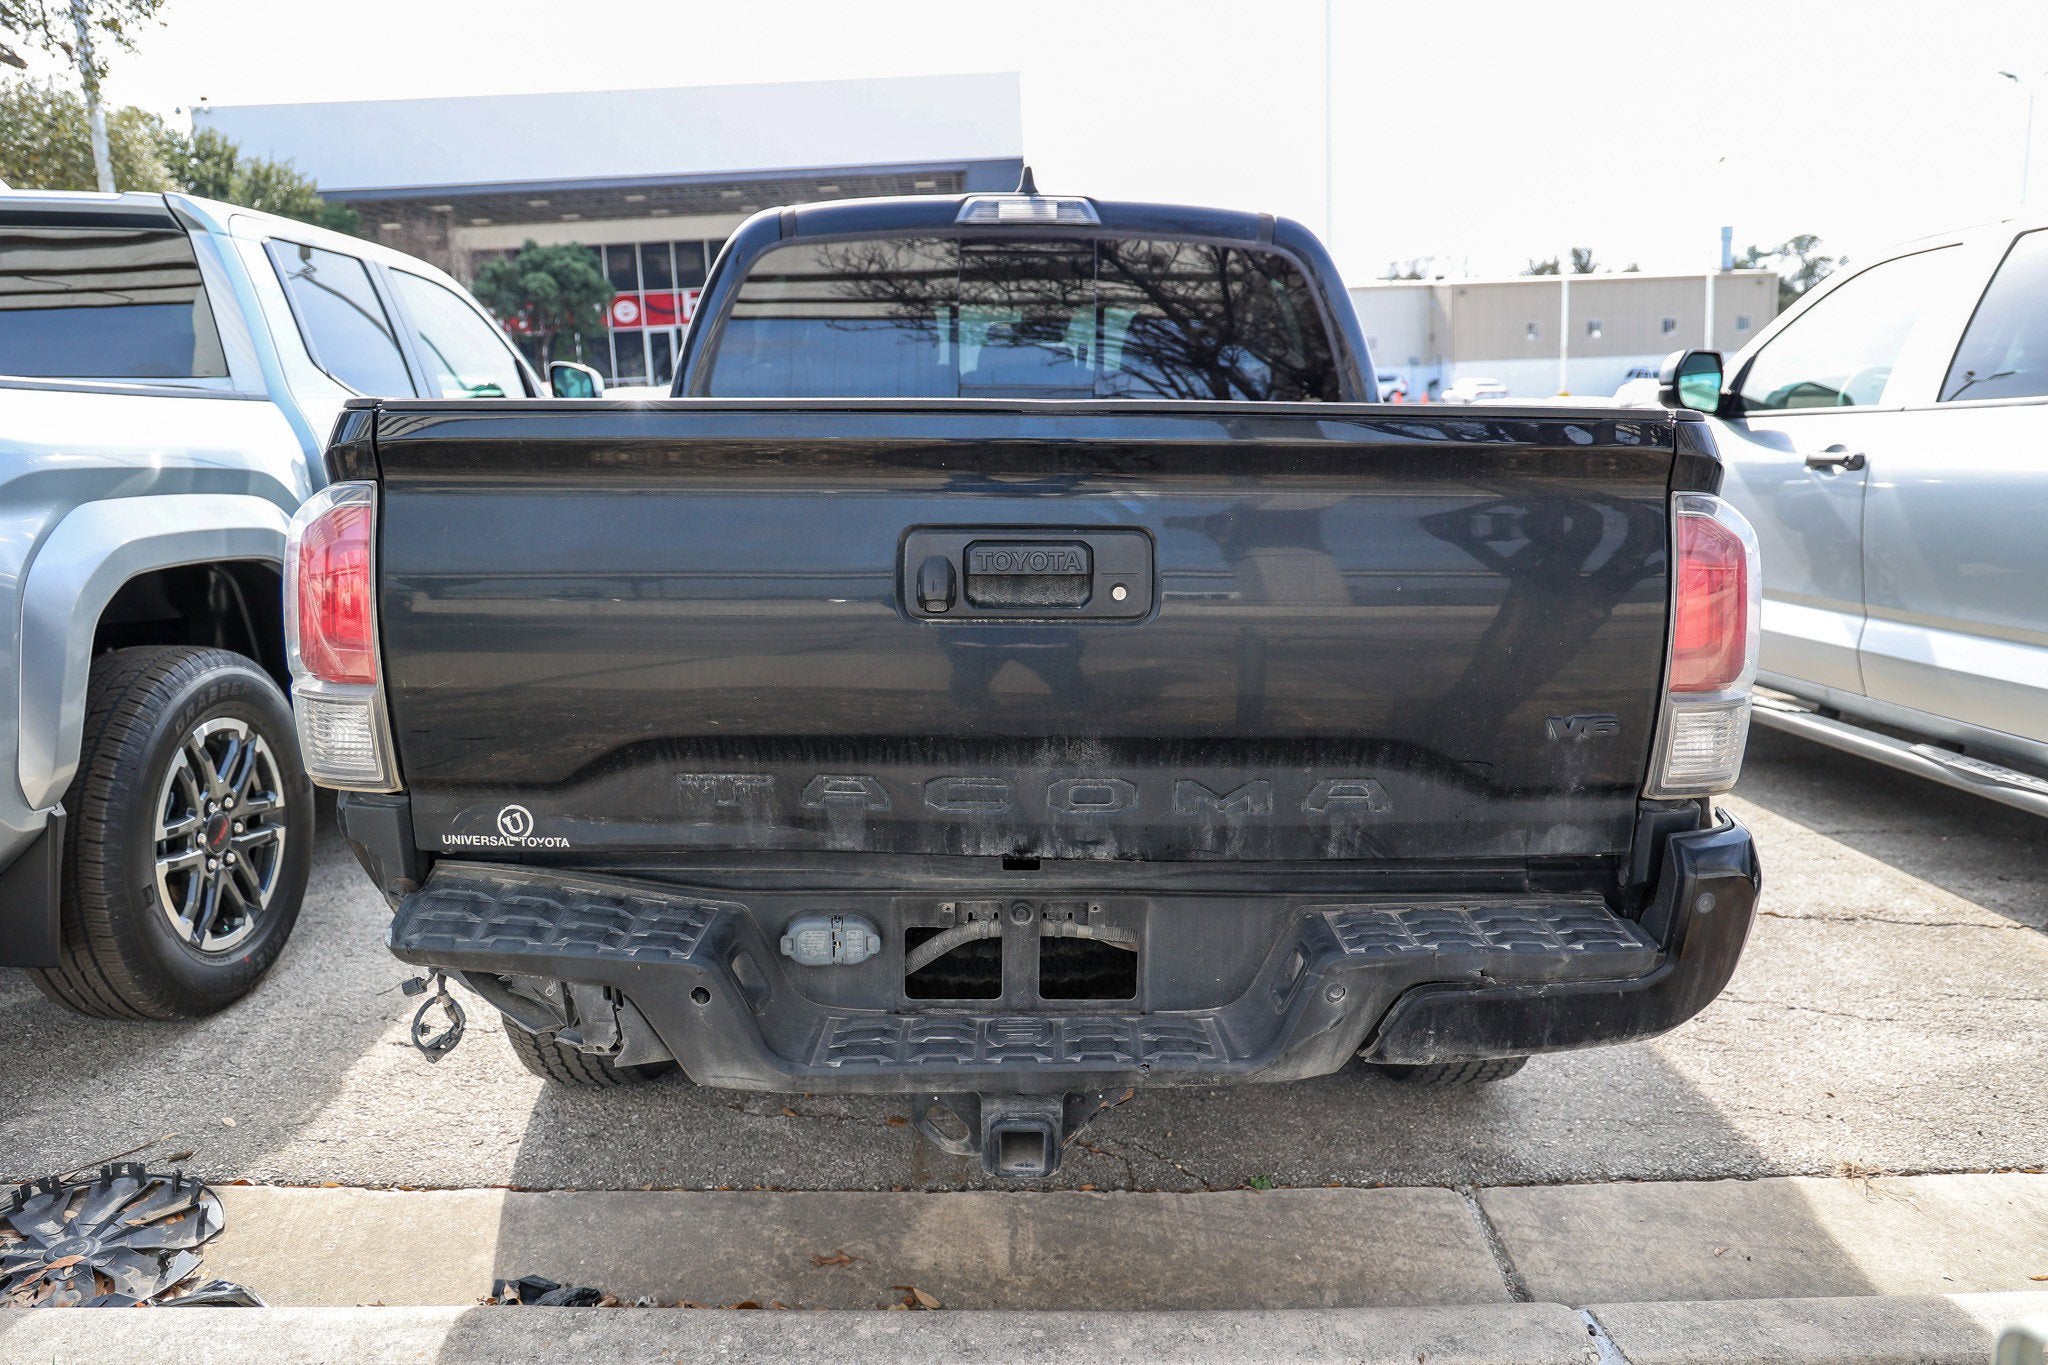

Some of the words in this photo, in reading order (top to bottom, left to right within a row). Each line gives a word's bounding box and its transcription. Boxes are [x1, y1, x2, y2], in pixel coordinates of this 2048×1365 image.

[976, 551, 1082, 571] TOYOTA
[673, 772, 1391, 814] TACOMA
[442, 834, 514, 847] UNIVERSAL
[520, 837, 570, 848] TOYOTA
